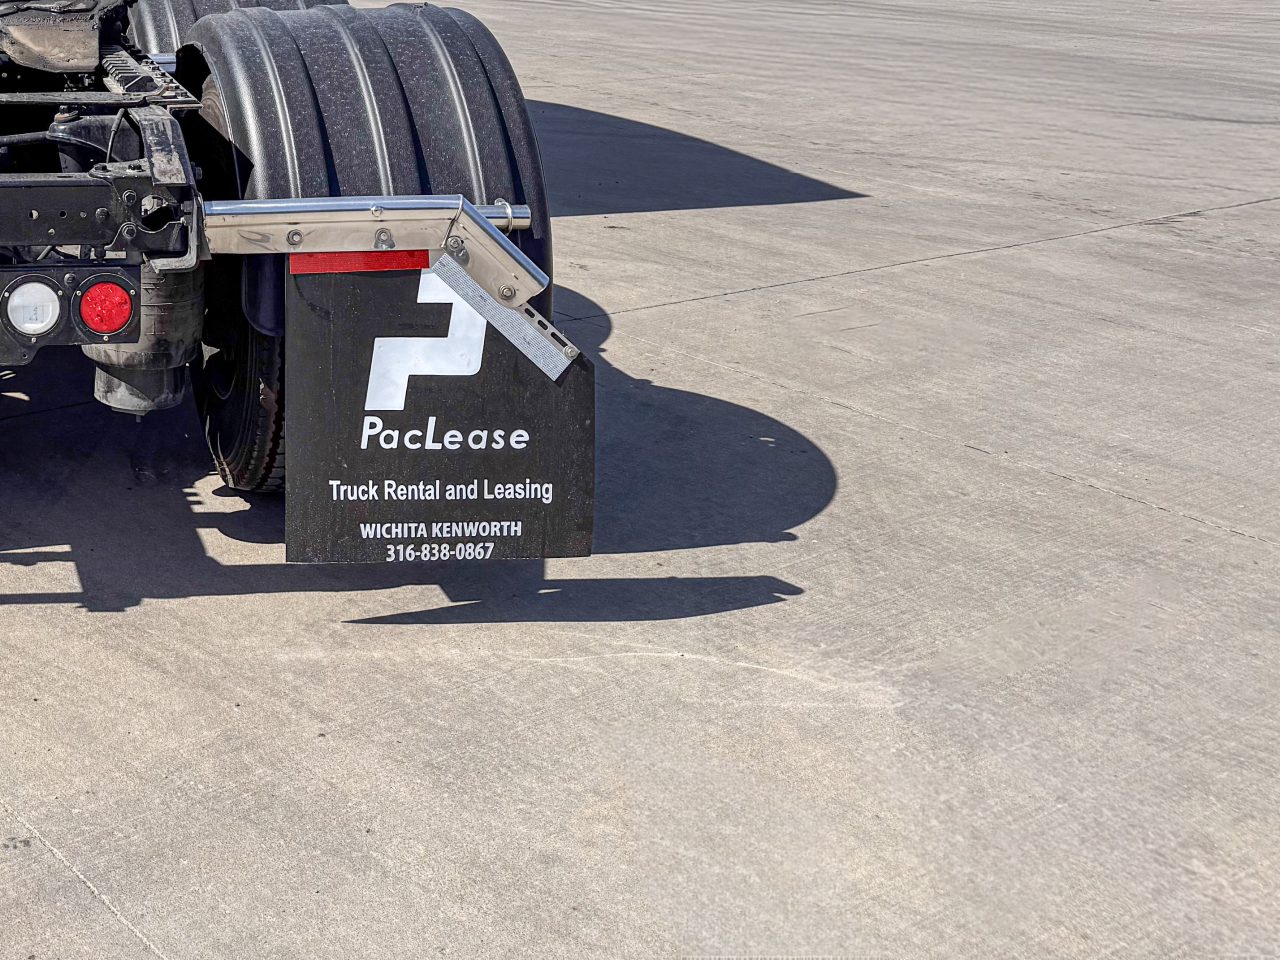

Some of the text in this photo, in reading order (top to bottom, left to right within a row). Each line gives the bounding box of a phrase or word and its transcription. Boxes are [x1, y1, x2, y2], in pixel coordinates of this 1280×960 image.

[359, 415, 531, 451] PacLease
[328, 478, 554, 504] Truck Rental and Leasing
[359, 521, 522, 539] WICHITA KENWORTH
[385, 542, 495, 563] 316-838-0867
